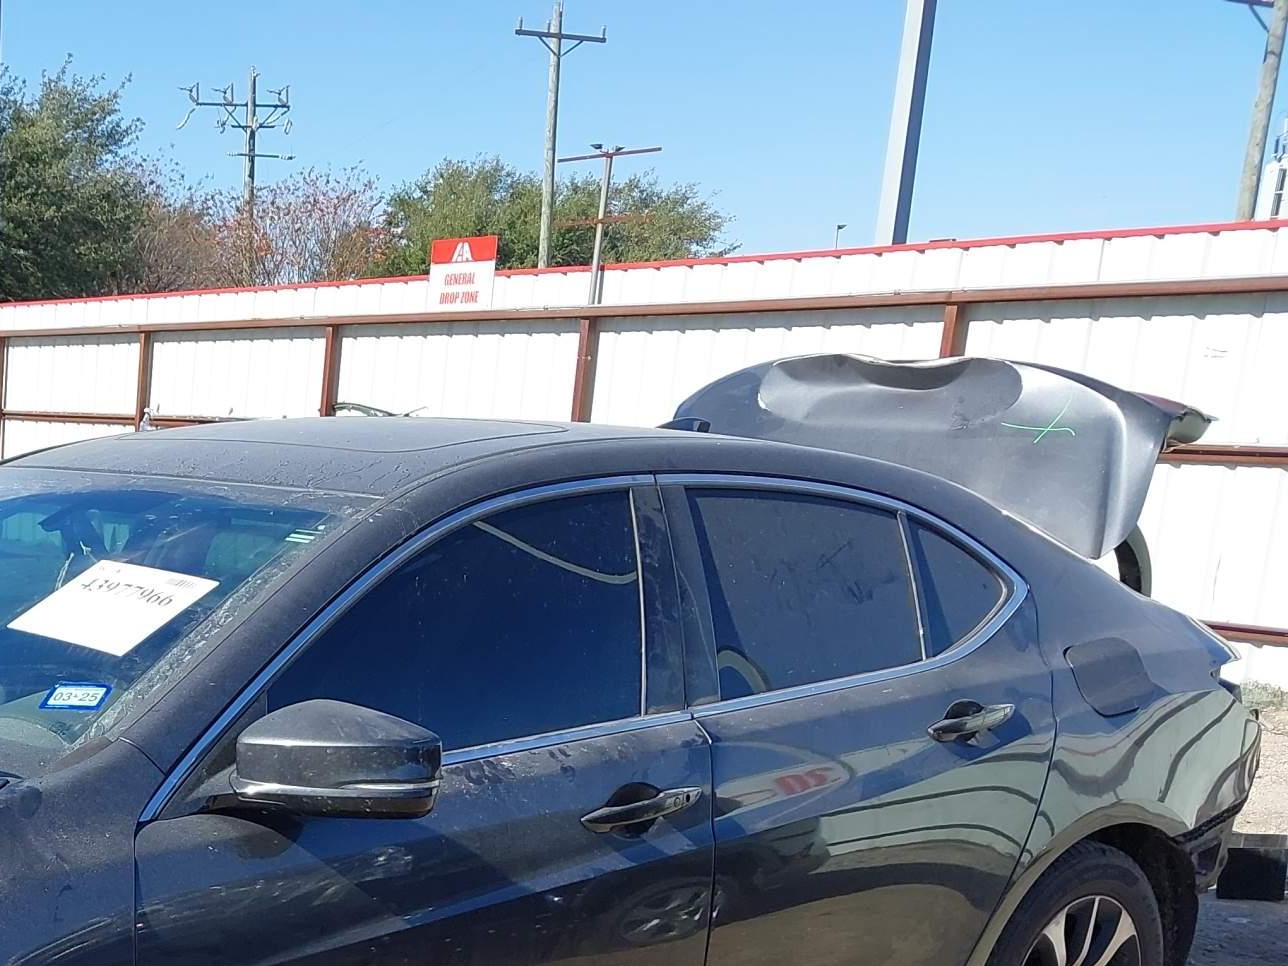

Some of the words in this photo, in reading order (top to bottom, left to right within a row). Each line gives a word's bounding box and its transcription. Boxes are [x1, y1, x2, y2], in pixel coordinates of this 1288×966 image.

[444, 272, 476, 286] GENERAL
[439, 292, 460, 304] DROP
[460, 291, 479, 304] ZONE
[80, 576, 170, 604] 43977966
